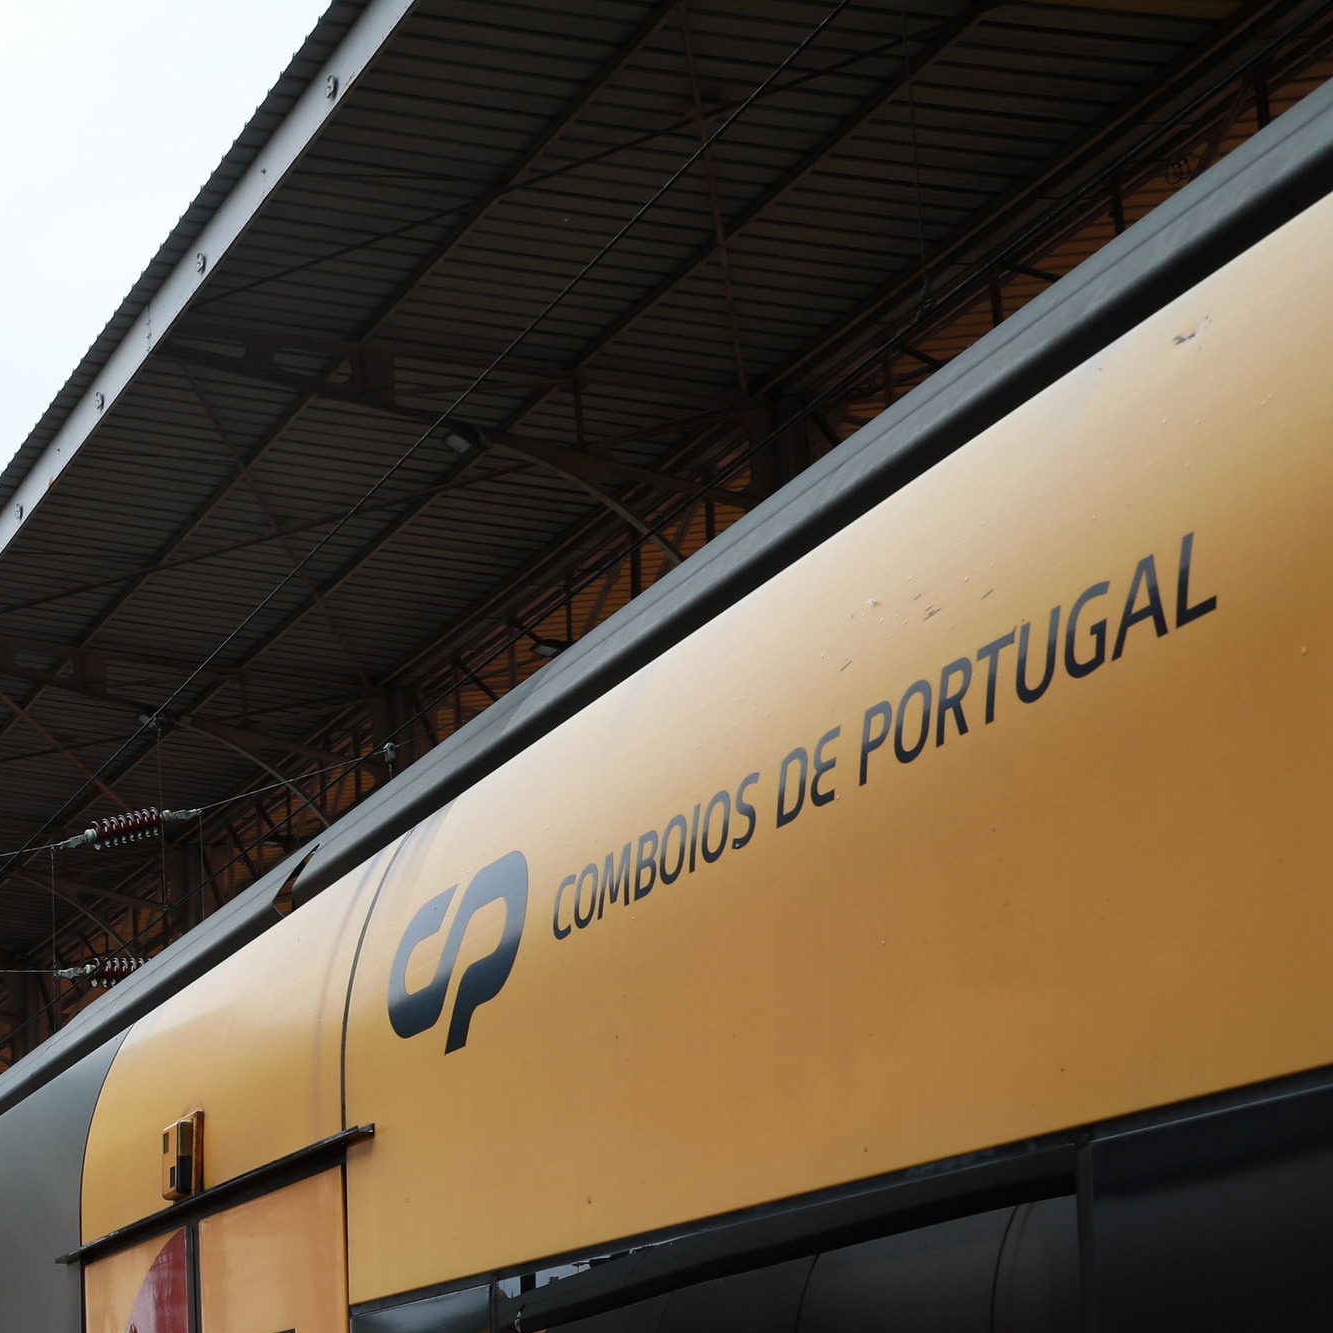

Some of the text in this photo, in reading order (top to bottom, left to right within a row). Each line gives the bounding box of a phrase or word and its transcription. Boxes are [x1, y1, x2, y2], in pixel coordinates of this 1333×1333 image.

[551, 531, 1219, 941] COMBOIOS DE PORTUGAL
